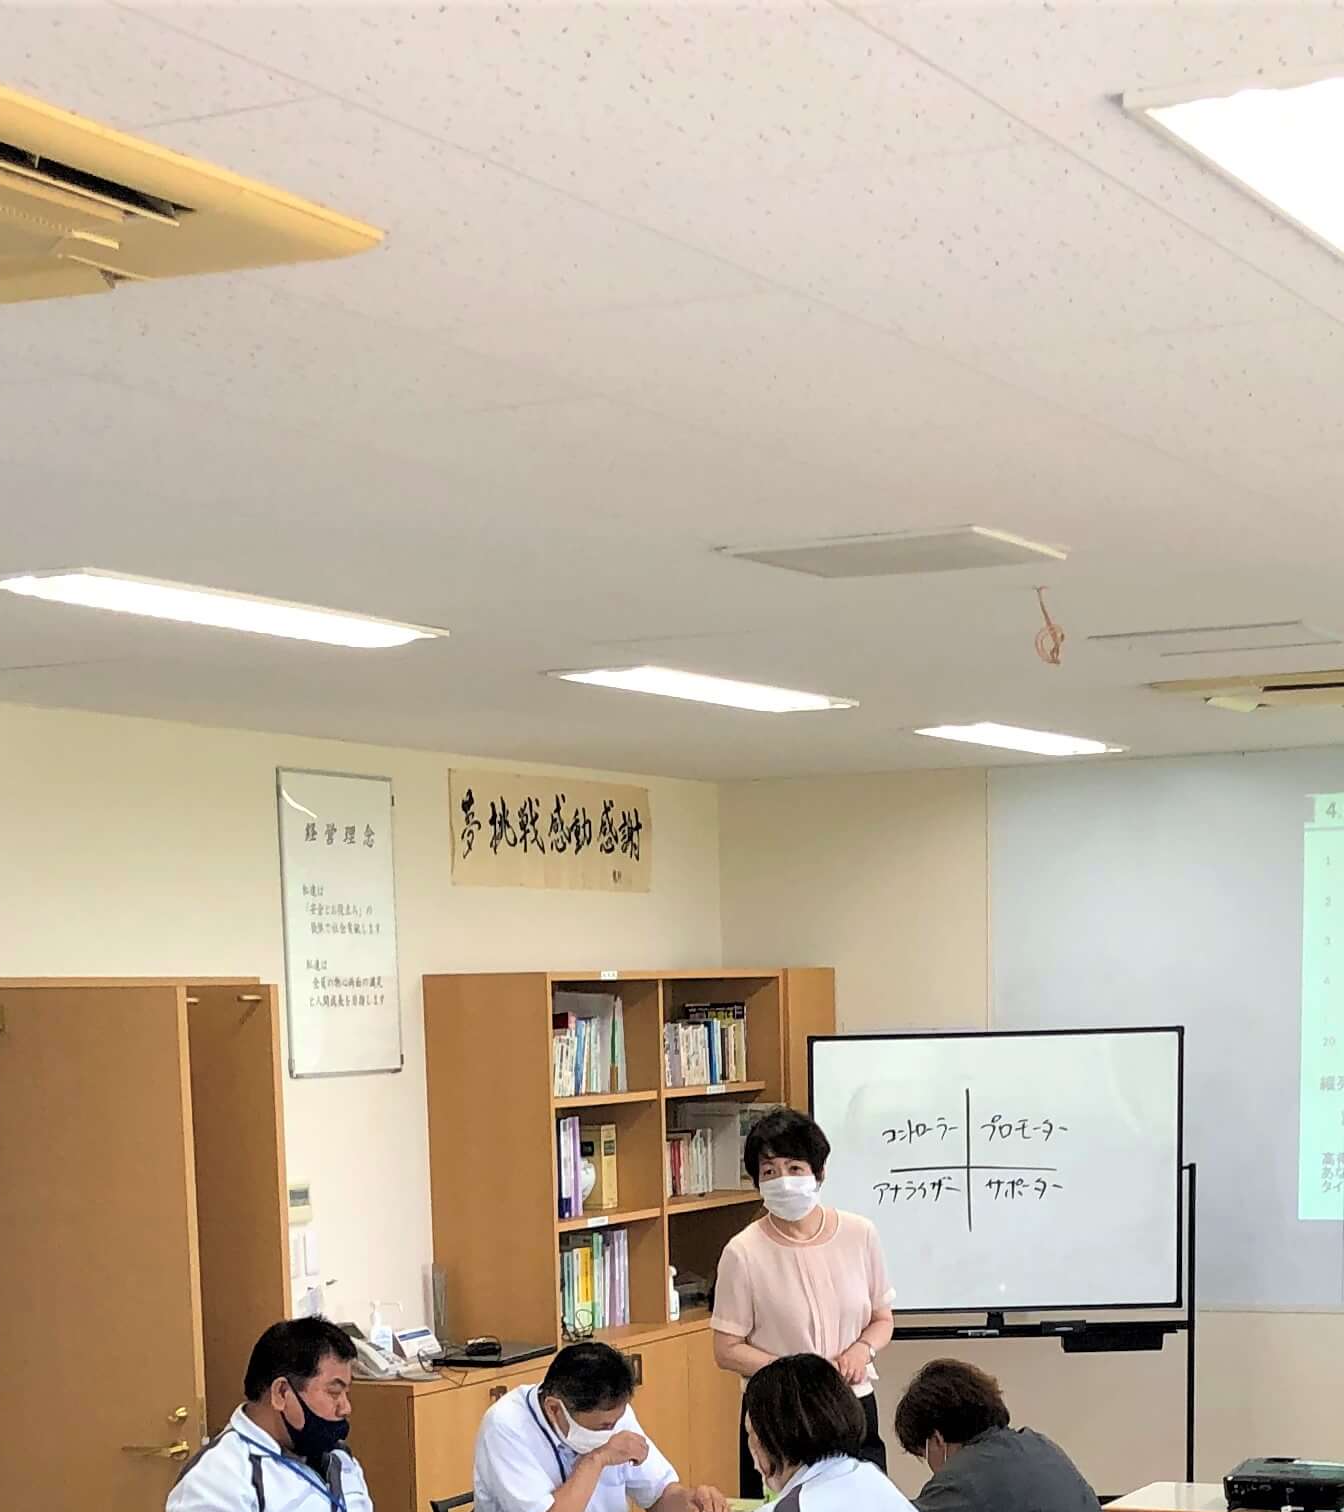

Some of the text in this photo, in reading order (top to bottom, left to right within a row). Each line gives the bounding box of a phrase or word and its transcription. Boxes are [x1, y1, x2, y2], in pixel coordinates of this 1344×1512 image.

[304, 822, 375, 849] 経営理念
[981, 1114, 1068, 1142] プロモーター
[872, 1174, 1064, 1205] アナライザー サポーター
